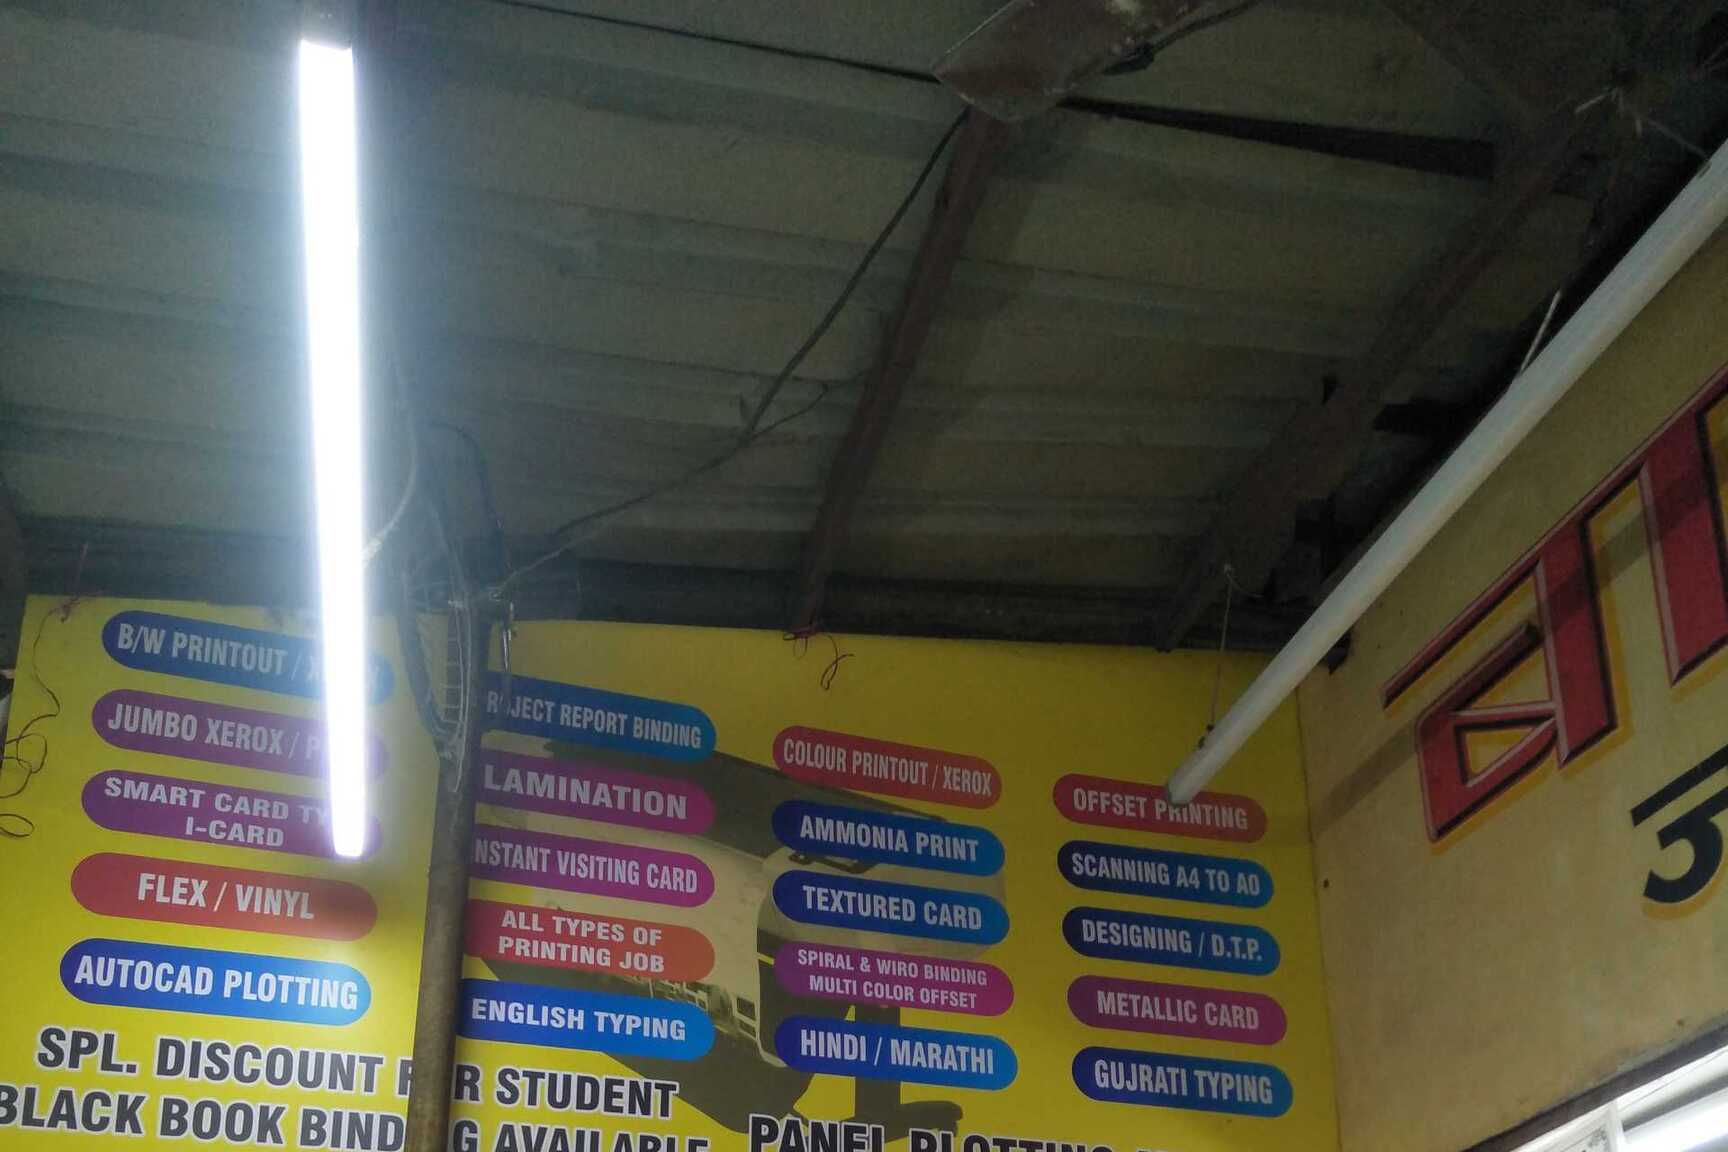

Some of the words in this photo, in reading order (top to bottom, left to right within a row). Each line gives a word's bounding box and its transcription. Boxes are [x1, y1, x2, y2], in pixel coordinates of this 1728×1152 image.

[117, 622, 165, 655] B/W
[172, 631, 289, 675] PRINTOUT
[107, 702, 198, 742] JUMBO
[204, 717, 284, 756] XEROX
[486, 690, 555, 723] RJECT
[560, 703, 628, 733] REPORT
[633, 717, 702, 749] BINDING
[783, 738, 846, 773] COLOUR
[852, 750, 928, 786] PRINTOUT
[942, 765, 993, 796] XEROX
[104, 776, 206, 810] SMART
[214, 791, 290, 821] CARD
[484, 763, 687, 820] LAMINATION
[1073, 788, 1148, 819] OFFSET
[1155, 799, 1249, 830] PRINTING
[185, 816, 284, 847] I-CARD
[800, 815, 908, 853] AMMONIA
[916, 832, 979, 862] PRINT
[474, 838, 551, 876] NSTANT
[556, 850, 640, 886] VISITING
[646, 863, 699, 893] CARD
[1071, 852, 1170, 885] SCANNING
[1176, 866, 1200, 889] A4
[1204, 869, 1230, 892] TO
[138, 872, 208, 908] FLEX
[235, 883, 315, 920] VINYL
[803, 884, 916, 923] TEXTURED
[923, 901, 982, 931] CARD
[501, 910, 544, 932] ALL
[552, 916, 625, 943] TYPES
[633, 926, 662, 947] OF
[1082, 918, 1193, 954] DESIGNING
[1211, 933, 1263, 961] D.T.P.
[498, 935, 611, 968] PRINTING
[619, 951, 665, 974] JOB
[798, 949, 854, 971] SPIRAL
[859, 956, 871, 973] &
[876, 958, 919, 978] WIRO
[924, 966, 988, 986] BINDING
[74, 954, 213, 996] AUTOCAD
[223, 969, 358, 1011] PLOTTING
[809, 975, 857, 996] MULTI
[863, 981, 915, 1002] COLOR
[920, 988, 977, 1009] OFFSET
[471, 998, 585, 1031] ENGLISH
[593, 1010, 686, 1042] TYPING
[1097, 990, 1198, 1024] METALLIC
[1204, 1002, 1260, 1030] CARD
[38, 1026, 138, 1074] SPL.
[156, 1037, 385, 1096] DISCOUNT
[496, 1067, 677, 1118] STUDENT
[801, 1029, 866, 1062] HINDI
[890, 1038, 994, 1074] MARATHI
[1094, 1059, 1188, 1096] GUJRATI
[1194, 1070, 1273, 1105] TYPING
[0, 1084, 145, 1135] BLACK
[160, 1097, 286, 1145] BOOK
